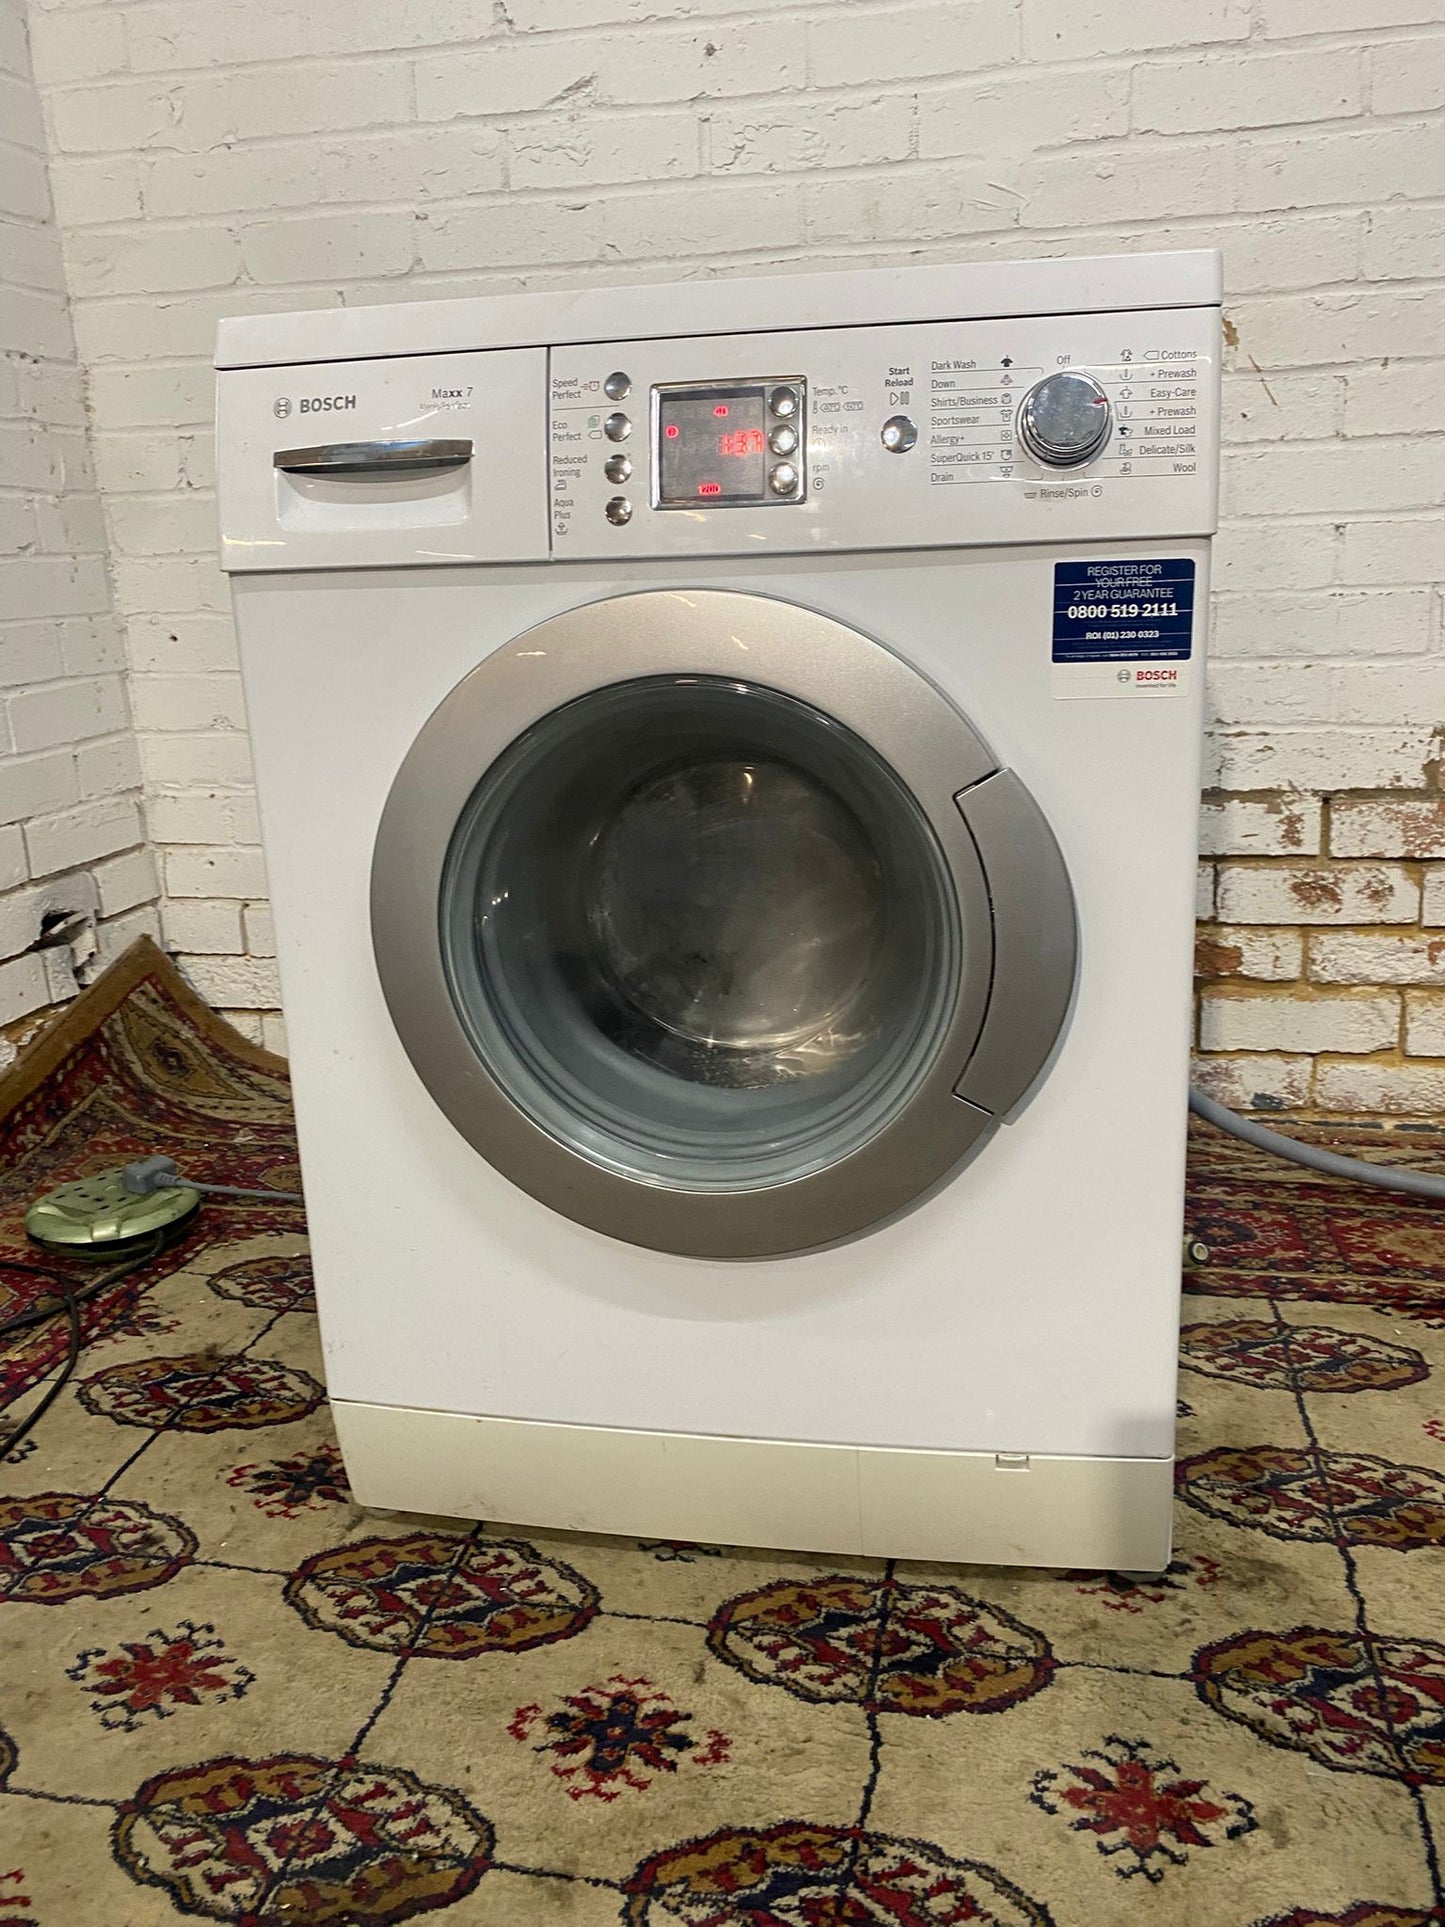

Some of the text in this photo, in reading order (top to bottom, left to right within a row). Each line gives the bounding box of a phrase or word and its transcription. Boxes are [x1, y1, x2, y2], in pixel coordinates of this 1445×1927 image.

[1057, 355, 1071, 365] Off
[1161, 350, 1197, 360] Cottons
[932, 360, 976, 371] Dark Wash
[888, 367, 910, 376] Start
[1158, 367, 1197, 378] Prewash
[552, 378, 578, 388] Speed
[884, 377, 914, 388] Reload
[932, 380, 956, 389] Down
[432, 386, 474, 399] Maxx 7
[552, 390, 582, 400] Perfect
[812, 386, 838, 398] Temp.
[1150, 387, 1197, 399] Easy-Care
[300, 395, 356, 413] BOSCH
[931, 396, 998, 407] Shirts/Business
[1158, 406, 1196, 416] Prewash
[552, 421, 567, 430] Eco
[931, 416, 980, 427] Sportswear
[812, 424, 848, 436] Ready in
[1144, 424, 1196, 436] Mixed Load
[552, 432, 582, 442] Perfect
[1139, 444, 1196, 456] Delicate/Silk
[552, 454, 588, 465] Reduced
[931, 451, 980, 463] SuperQuick
[553, 467, 581, 478] Ironing
[812, 463, 830, 473] rpm
[1173, 463, 1196, 473] Wool
[930, 472, 954, 482] Drain
[1040, 487, 1088, 500] Rinse/Spin
[554, 498, 575, 508] Aqua
[554, 511, 571, 520] Plus
[1087, 564, 1162, 576] REGISTER FOR
[1095, 576, 1153, 588] YOUR FREE
[1073, 588, 1174, 600] 2 YEAR GUARANTEE
[1068, 603, 1178, 619] 0800 519 2111
[1085, 630, 1160, 640] ROI (01) 230 0323
[1136, 670, 1177, 681] BOSCH
